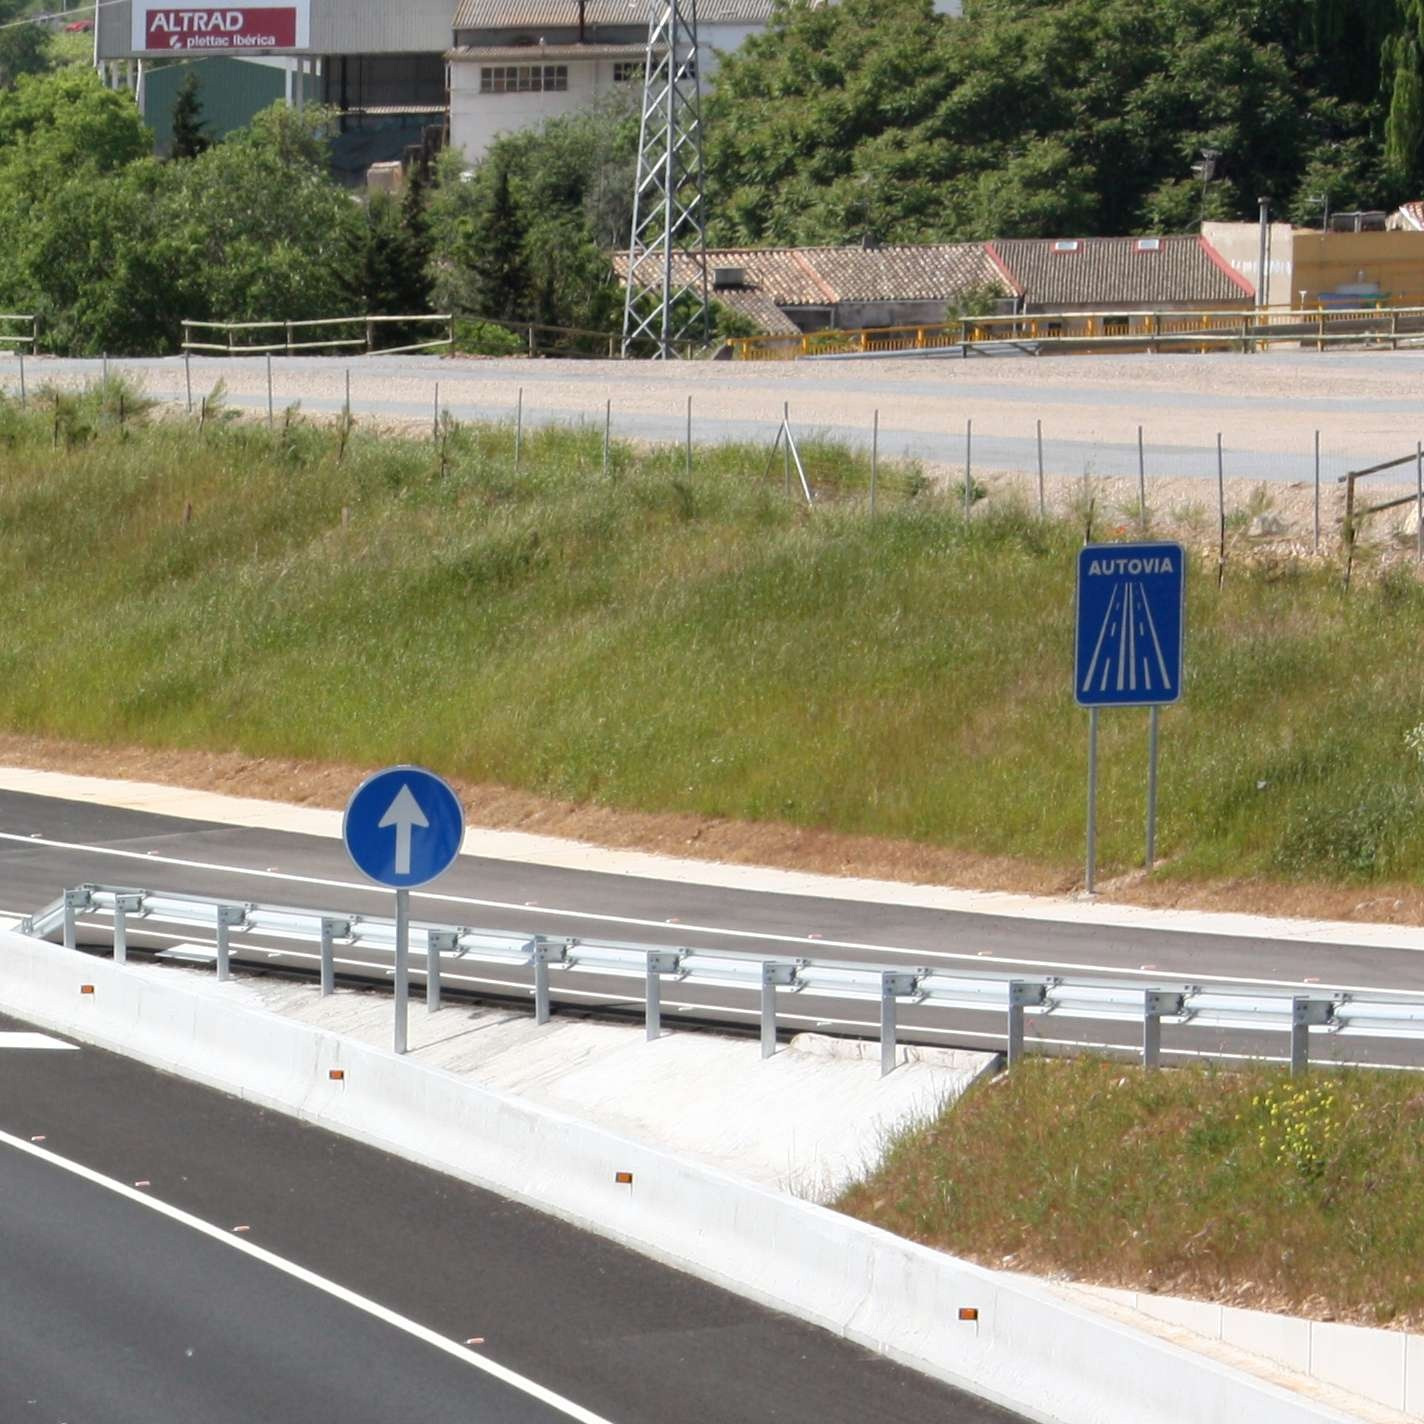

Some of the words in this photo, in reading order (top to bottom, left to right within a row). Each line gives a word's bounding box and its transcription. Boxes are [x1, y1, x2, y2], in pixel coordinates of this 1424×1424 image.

[150, 11, 244, 32] ALTRAD
[186, 35, 229, 48] plettac
[233, 33, 276, 46] Ibérica
[1088, 557, 1174, 576] AUTOVIA
